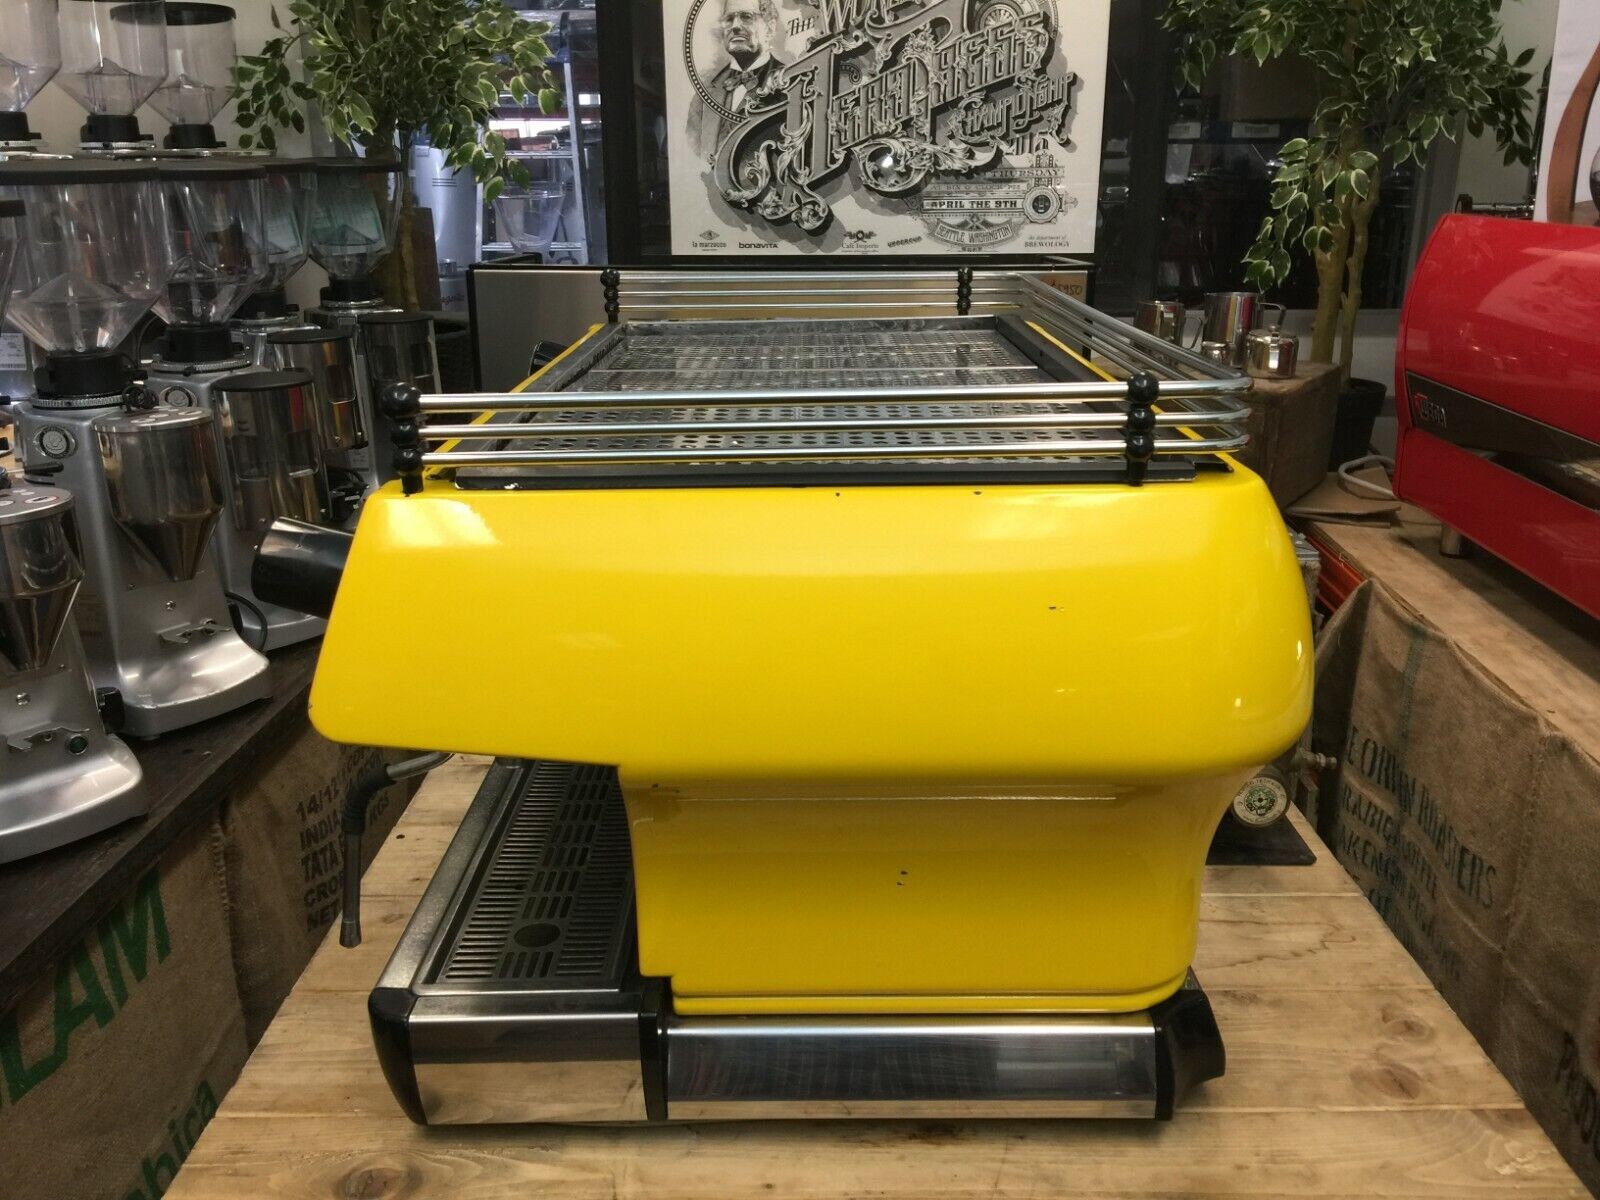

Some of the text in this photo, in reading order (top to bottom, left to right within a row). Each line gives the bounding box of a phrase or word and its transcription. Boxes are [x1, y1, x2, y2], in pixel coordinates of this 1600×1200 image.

[787, 16, 815, 37] THE
[991, 168, 1060, 178] THURSDAY
[930, 199, 1018, 209] APRIL THE 9TH
[936, 223, 1012, 244] SEATTLE WASHINGTON
